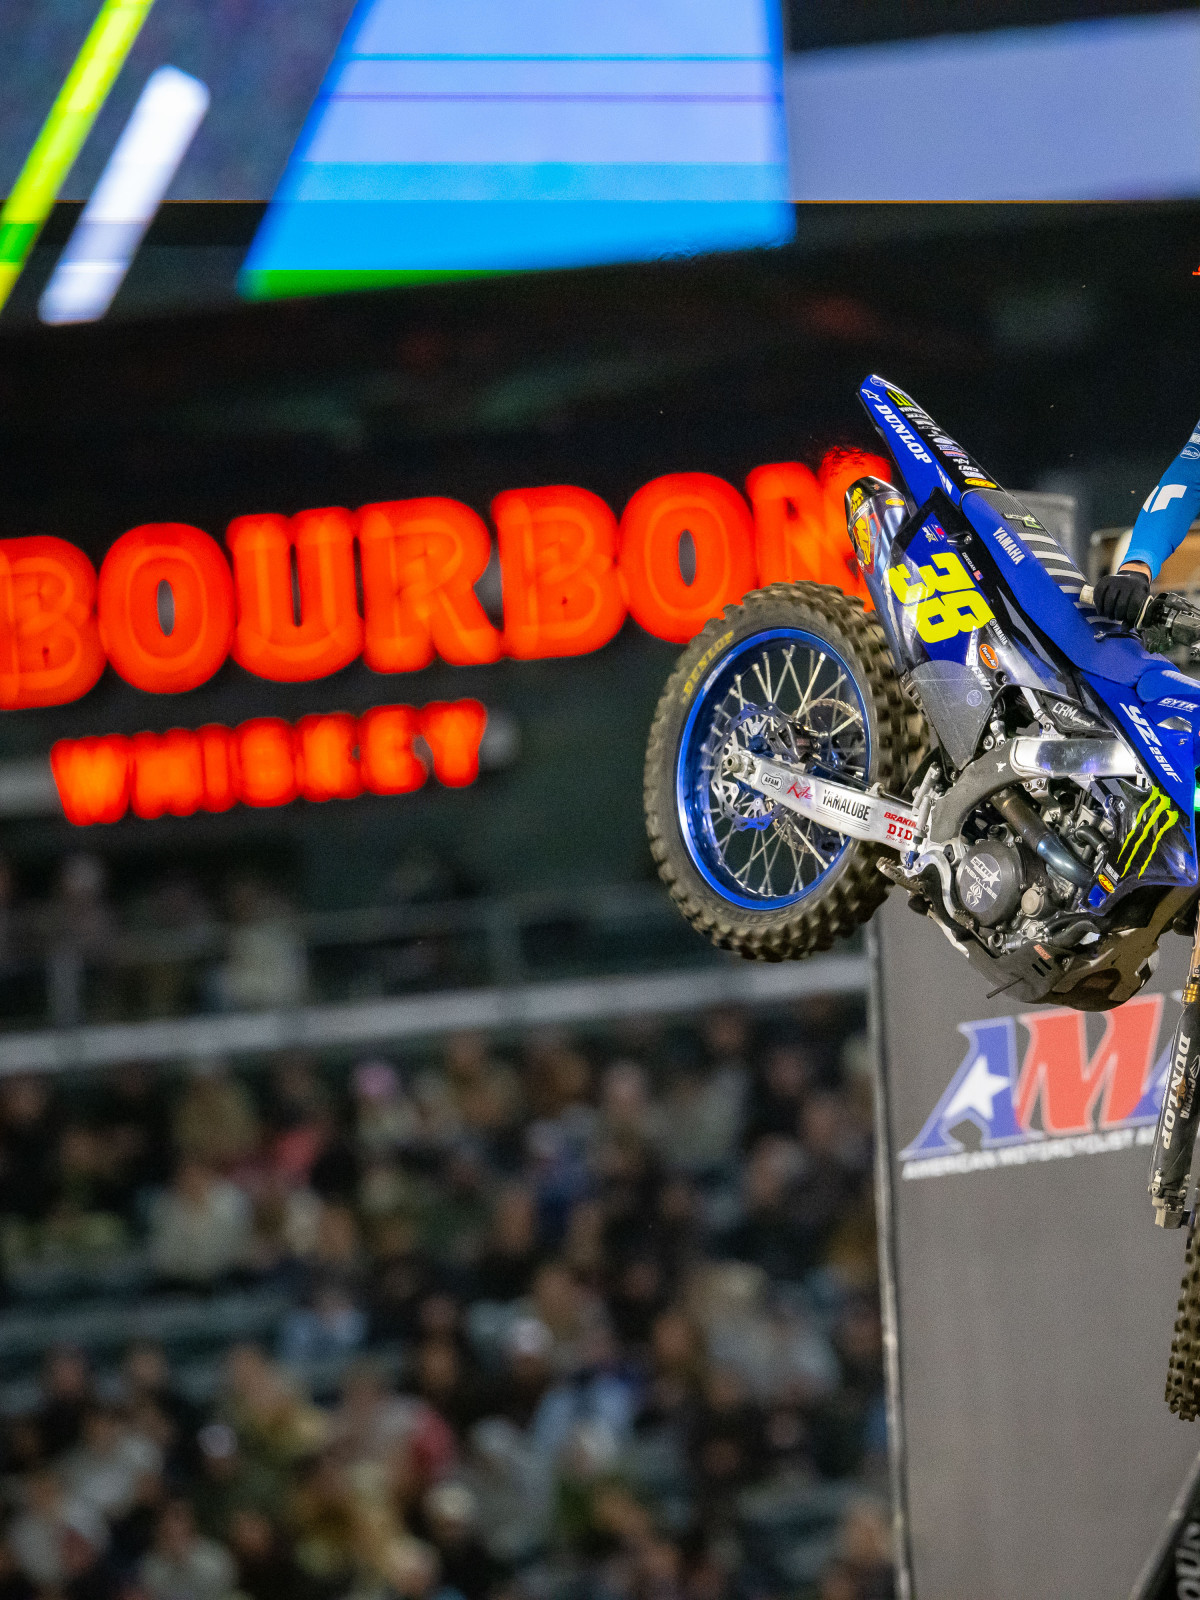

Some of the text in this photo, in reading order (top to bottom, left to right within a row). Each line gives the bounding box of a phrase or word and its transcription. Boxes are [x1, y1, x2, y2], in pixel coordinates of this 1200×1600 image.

[874, 404, 933, 464] DUNLOP
[992, 526, 1026, 566] YAMAHA
[0, 445, 892, 710] BOURBON
[887, 552, 996, 644] 38
[993, 622, 1009, 647] YAMAHA
[1052, 701, 1079, 720] CRM
[1159, 696, 1200, 711] GYTR
[763, 776, 780, 788] AFAM
[822, 789, 871, 822] YAMALUBE
[1163, 1031, 1192, 1151] DUNLOP
